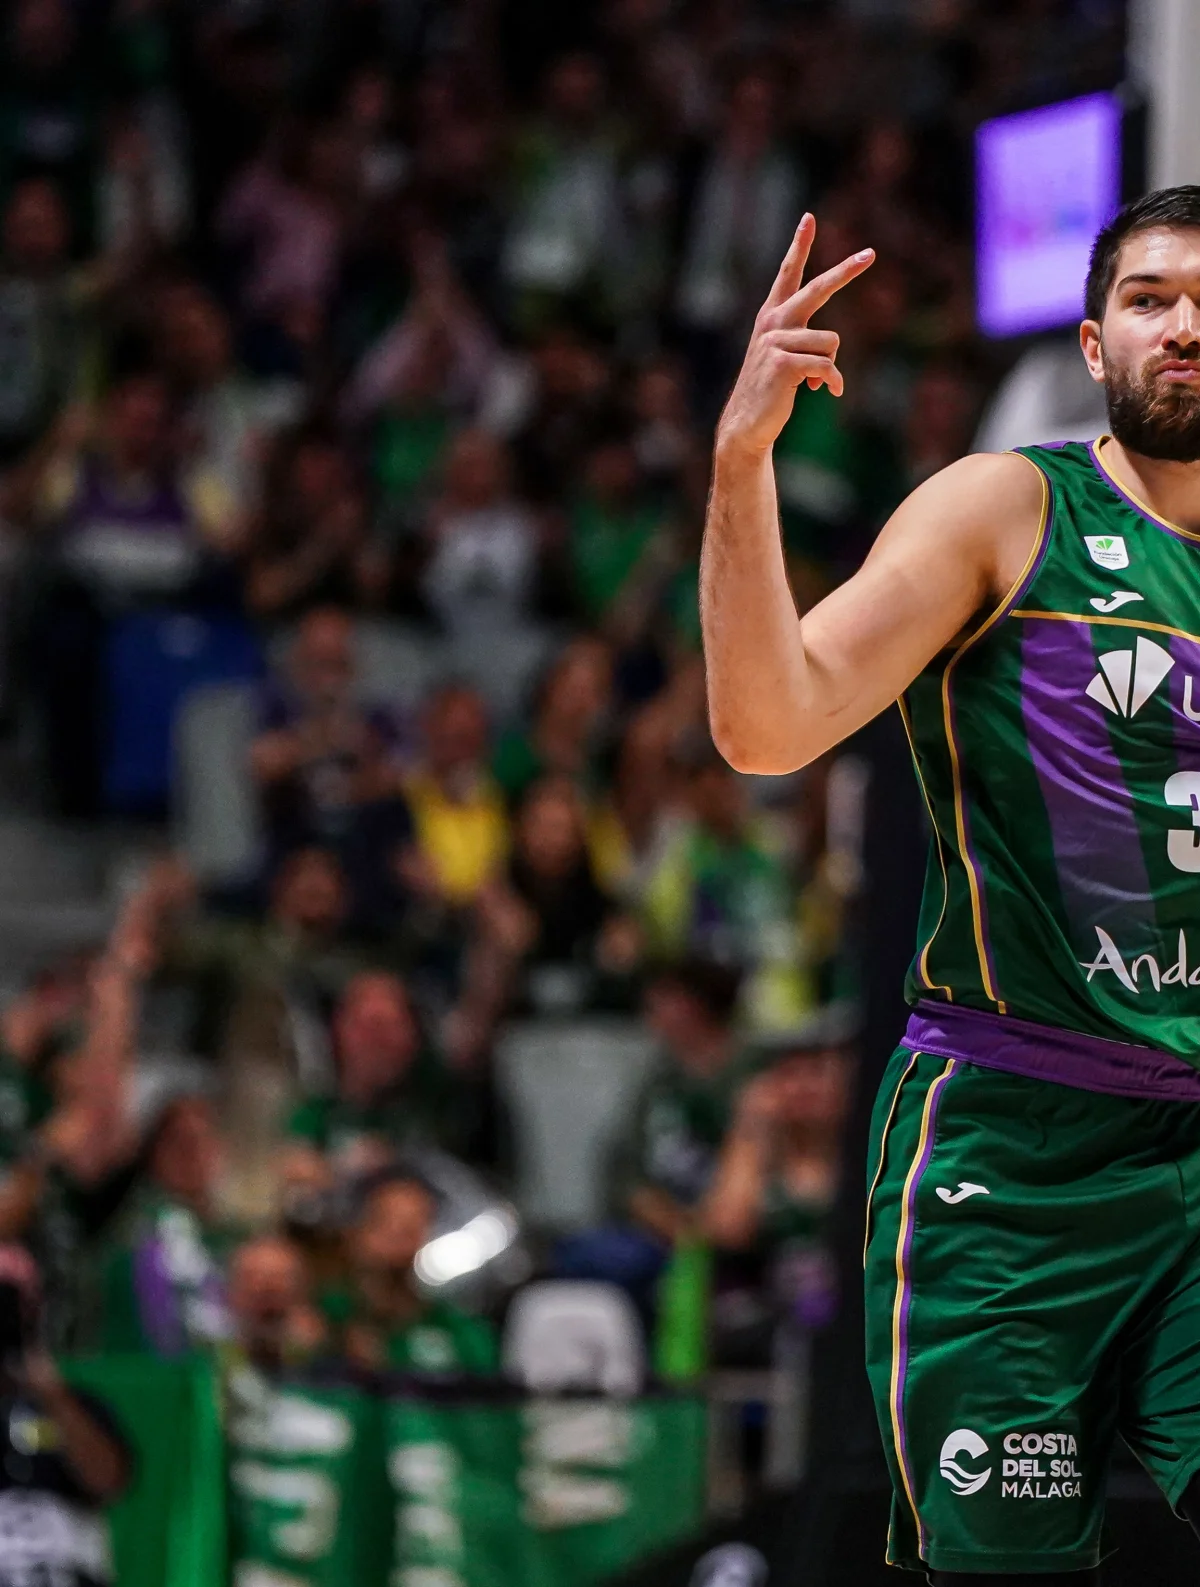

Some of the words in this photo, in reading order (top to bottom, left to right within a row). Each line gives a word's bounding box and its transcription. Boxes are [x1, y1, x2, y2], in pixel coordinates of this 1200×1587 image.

[1003, 1433, 1078, 1456] COSTA
[1002, 1459, 1046, 1477] DEL
[1050, 1459, 1082, 1477] SOL
[1001, 1478, 1082, 1498] MÁLAGA
